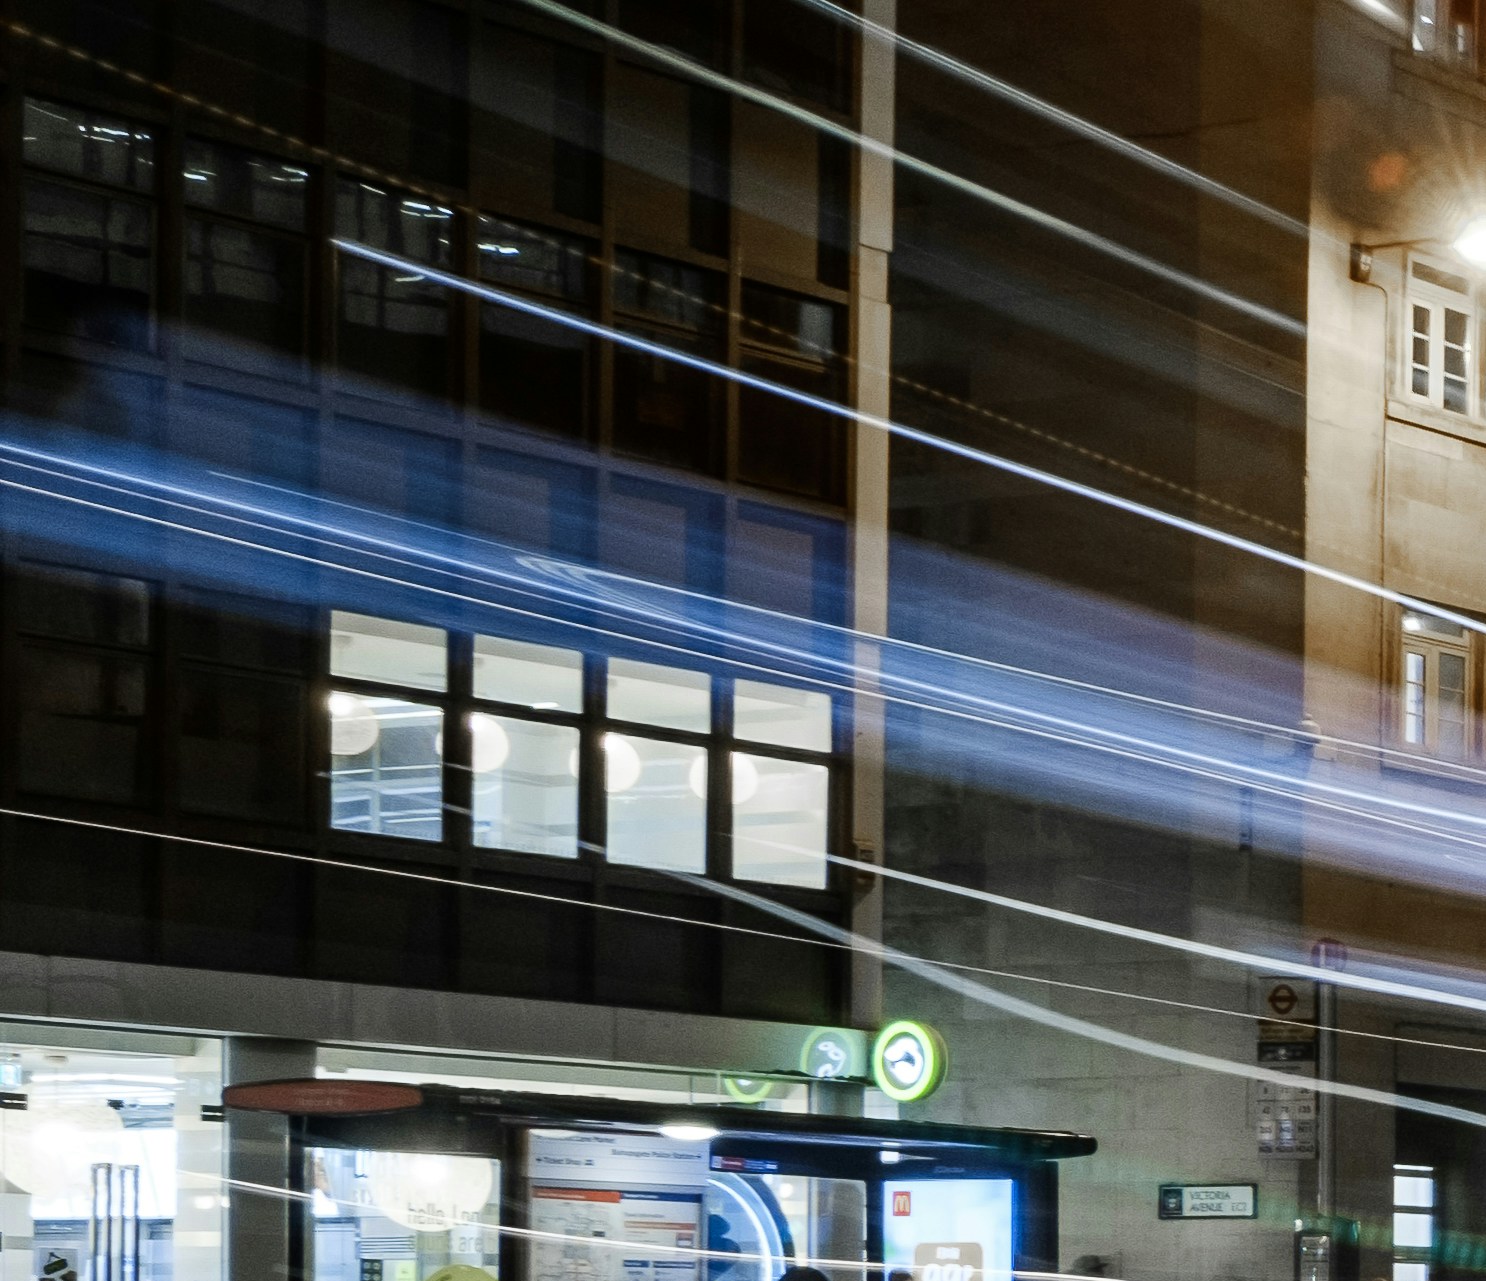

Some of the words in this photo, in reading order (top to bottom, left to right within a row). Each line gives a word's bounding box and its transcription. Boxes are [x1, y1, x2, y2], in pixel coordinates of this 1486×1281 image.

[1189, 1191, 1231, 1200] VICTORIA
[1189, 1202, 1224, 1212] AVENUE
[1231, 1202, 1248, 1212] EC2
